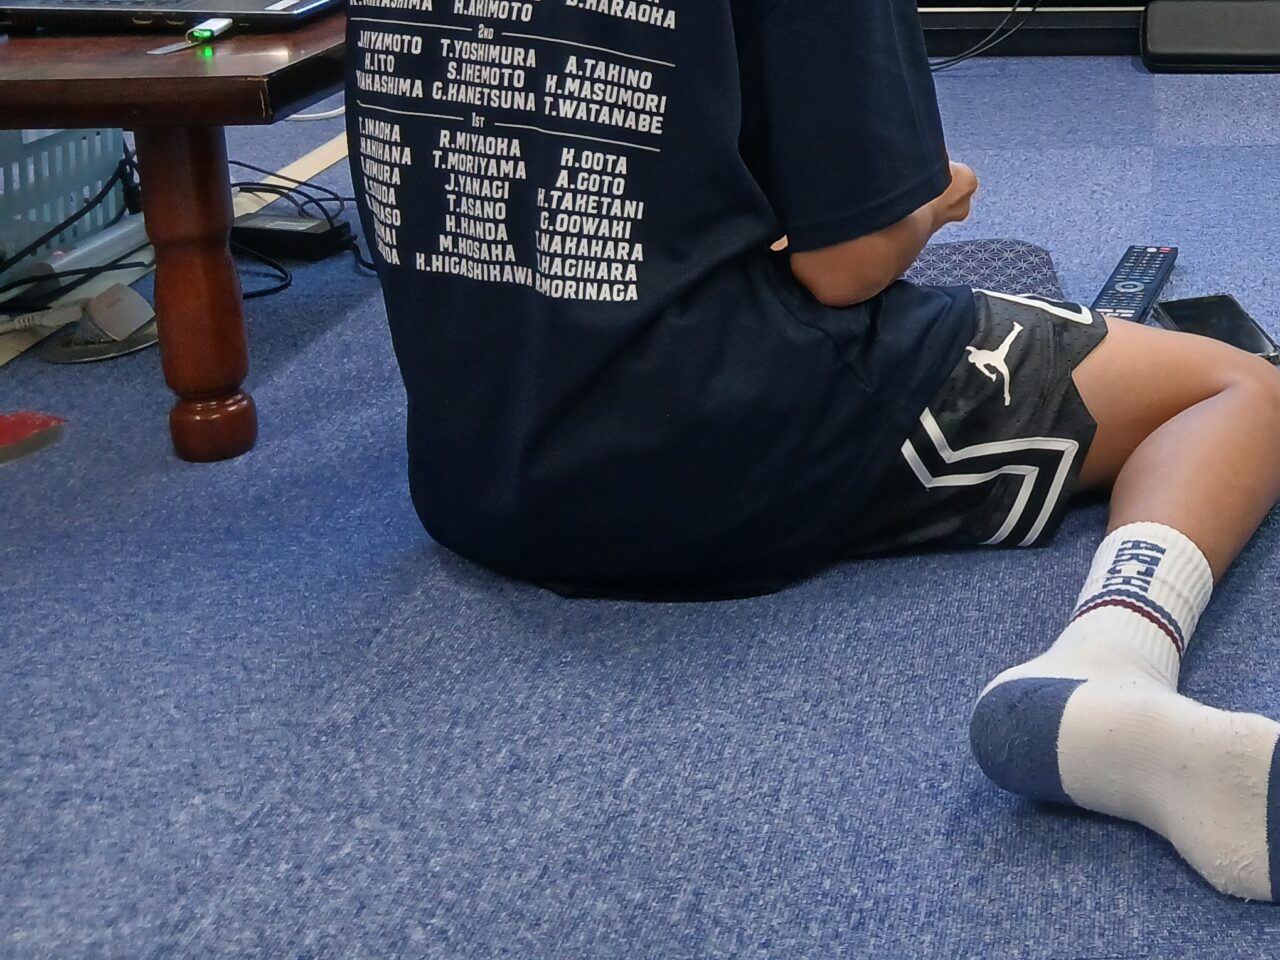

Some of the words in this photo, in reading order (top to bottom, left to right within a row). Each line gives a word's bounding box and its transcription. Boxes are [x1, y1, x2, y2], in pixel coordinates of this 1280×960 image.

[440, 38, 537, 67] T.YOSHIMURA
[543, 96, 663, 135] T.WATANABE
[432, 150, 527, 179] T.MORIYAMA
[444, 173, 510, 199] J.YANAGI
[555, 169, 626, 196] A.GOTO
[446, 194, 507, 220] T.ASANO
